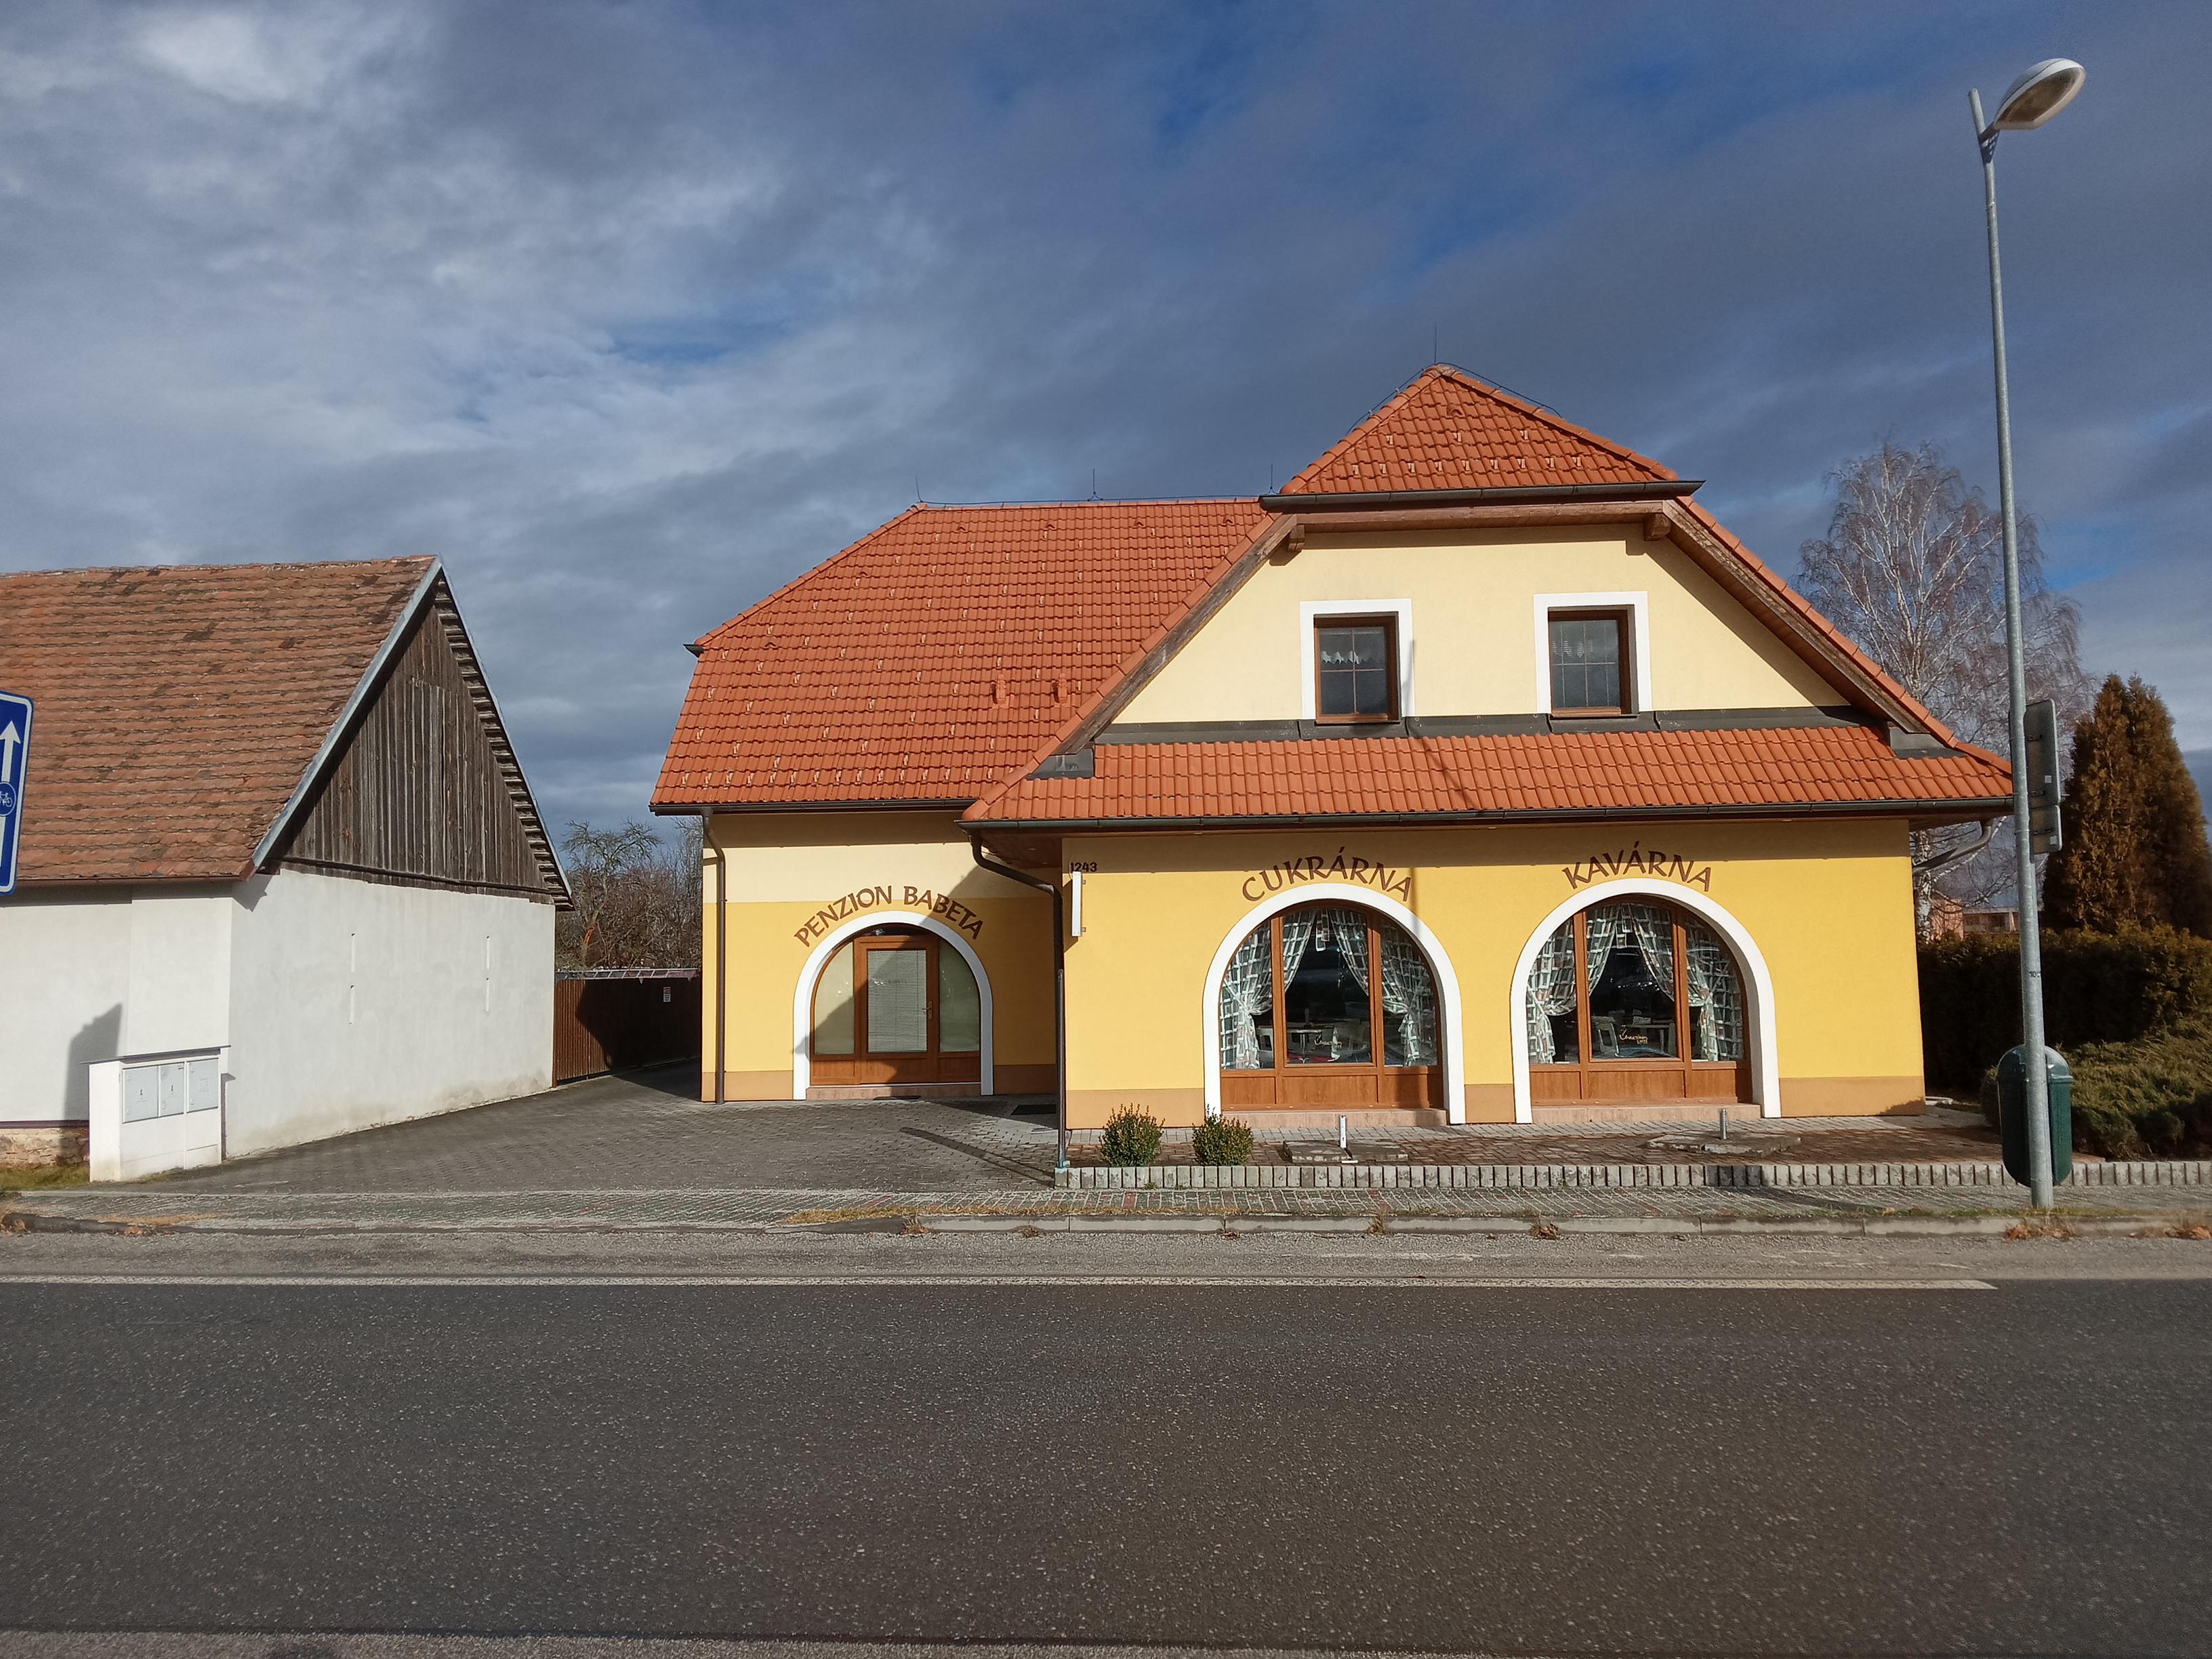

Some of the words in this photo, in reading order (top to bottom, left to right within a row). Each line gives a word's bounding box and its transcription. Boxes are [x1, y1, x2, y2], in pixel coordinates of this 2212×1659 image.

[1070, 861, 1097, 873] 1243
[1242, 846, 1412, 902] CUKRÁRNA
[1561, 840, 1711, 892] KAVÁRNA
[794, 885, 892, 947] PENZION
[903, 885, 984, 940] BABETA
